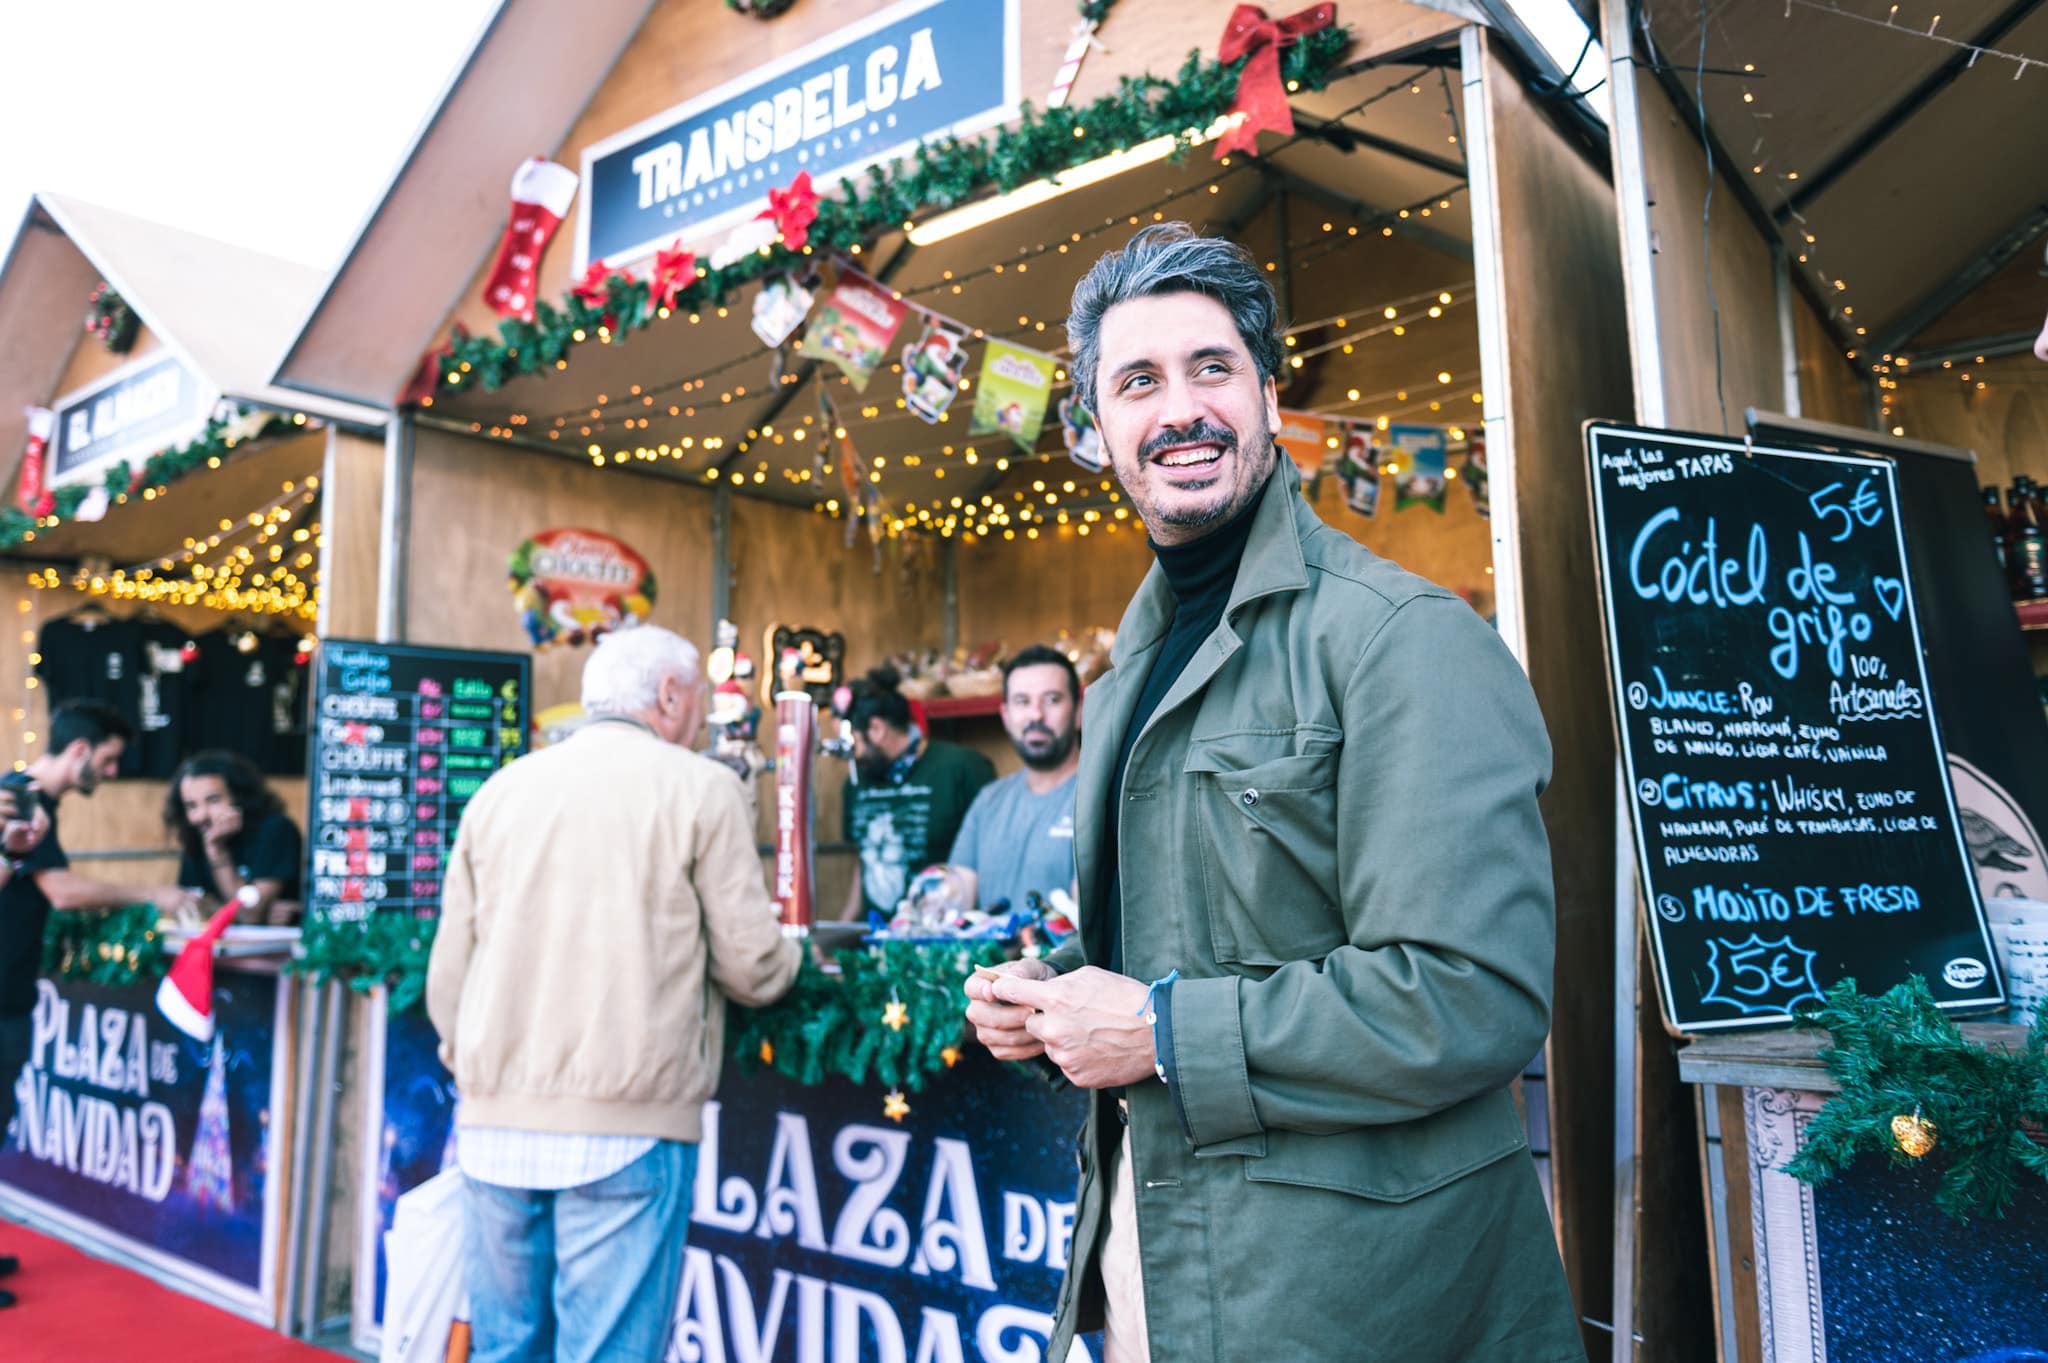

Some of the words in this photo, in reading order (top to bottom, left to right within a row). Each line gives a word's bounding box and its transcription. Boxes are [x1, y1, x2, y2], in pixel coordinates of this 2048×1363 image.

[632, 27, 942, 210] TRANSBELGA
[1617, 466, 1675, 491] mejores
[1675, 452, 1734, 479] TAPAS
[1639, 447, 1664, 464] las
[1808, 478, 1884, 543] 5€
[1629, 504, 1767, 608] Cóctel
[1786, 530, 1856, 605] de
[1768, 604, 1872, 680] grifo
[1850, 654, 1888, 680] 100%
[1829, 678, 1922, 714] Artesanales
[1653, 738, 1678, 754] DE
[1798, 723, 1841, 741] ZUMO
[1894, 790, 1916, 804] DE
[1774, 818, 1794, 834] DE
[1920, 815, 1938, 830] DE
[1663, 843, 1759, 867] ALMENDRAS
[1794, 885, 1834, 917] DE
[1838, 882, 1921, 915] FRESA
[1729, 947, 1805, 996] 5€
[32, 978, 149, 1098] PLAZA
[151, 1040, 179, 1084] DE
[8, 1061, 176, 1203] NAVIDAD
[690, 1100, 998, 1292] LAZA
